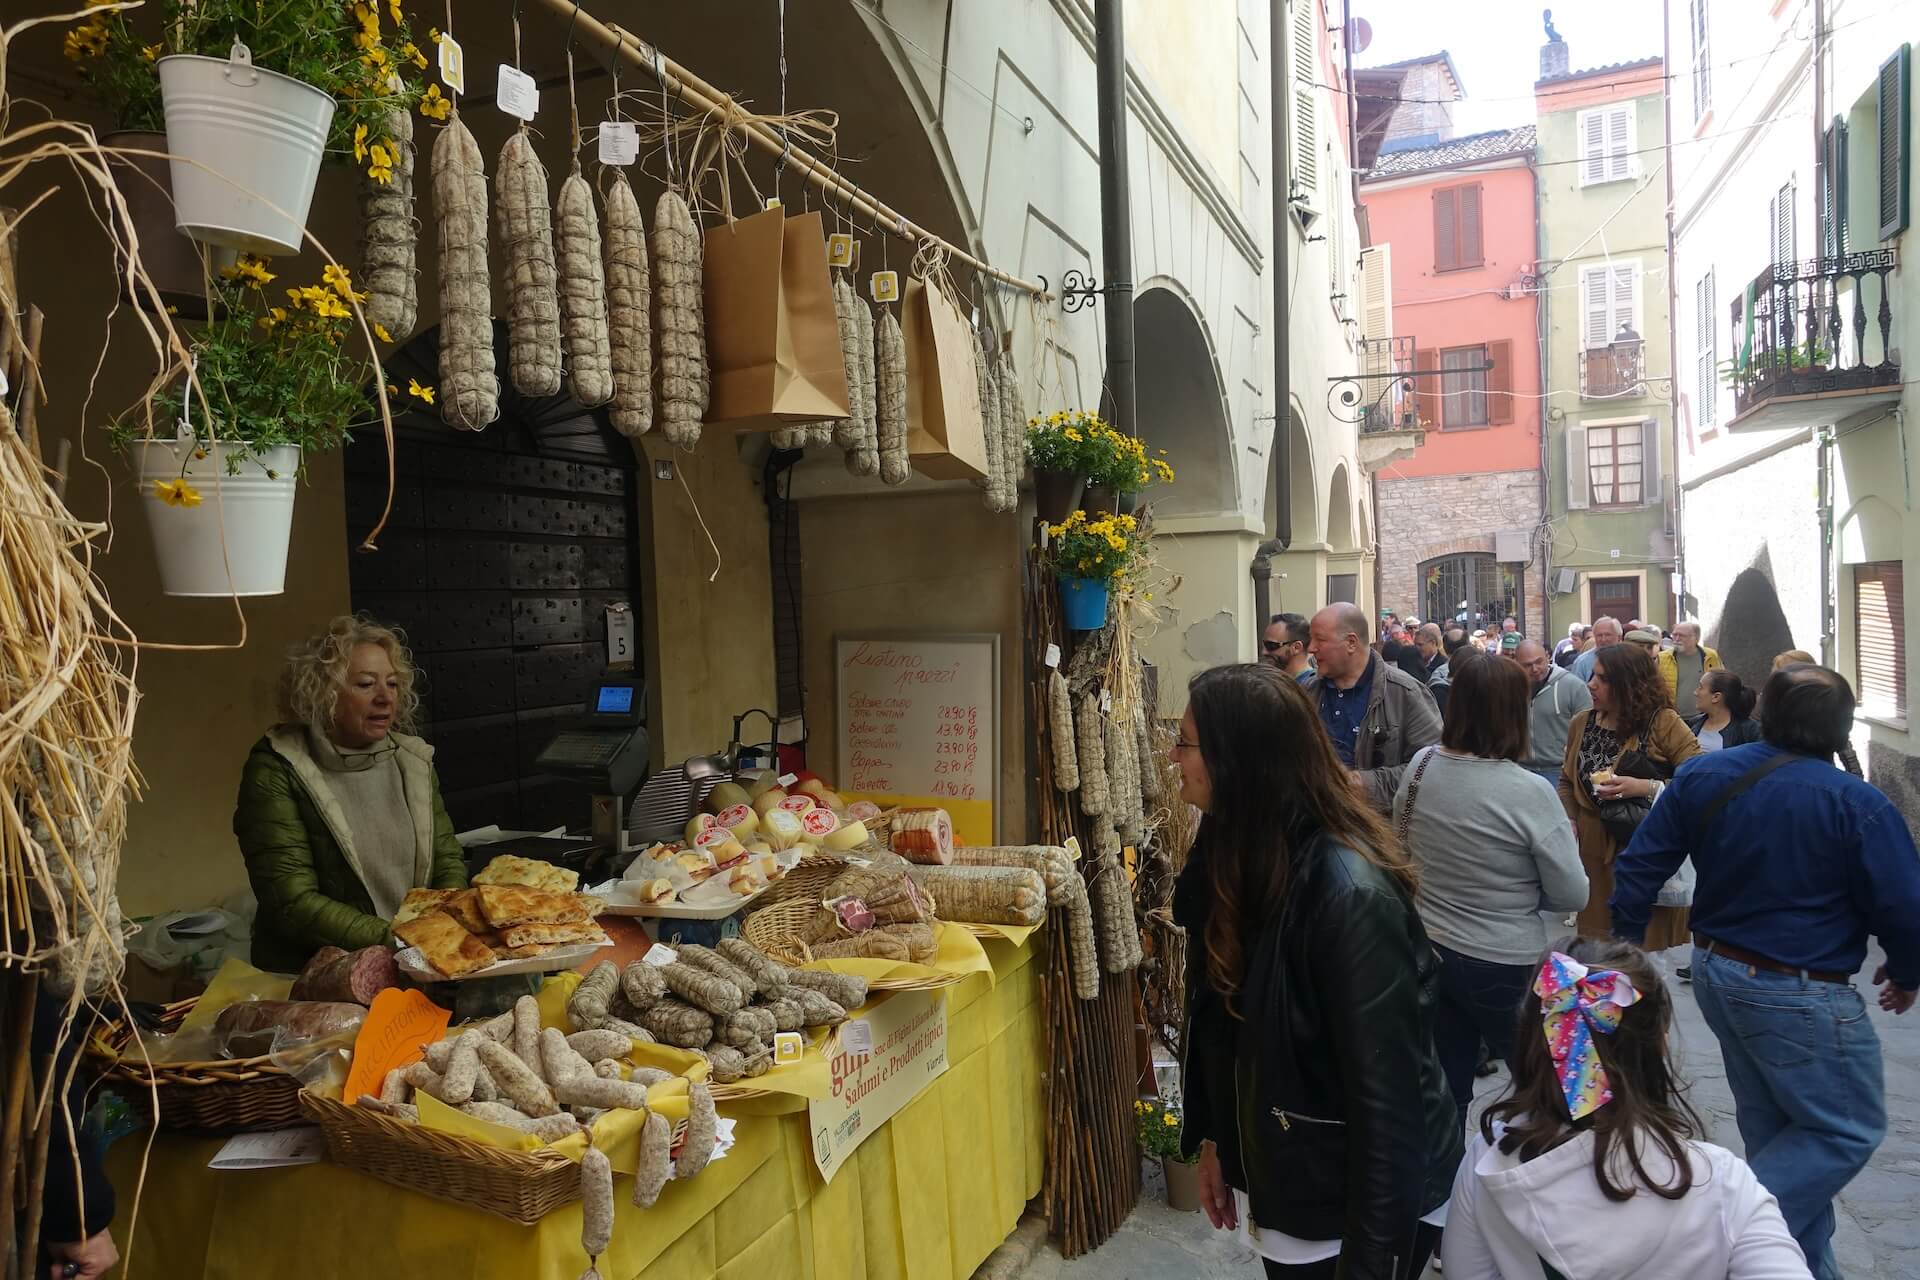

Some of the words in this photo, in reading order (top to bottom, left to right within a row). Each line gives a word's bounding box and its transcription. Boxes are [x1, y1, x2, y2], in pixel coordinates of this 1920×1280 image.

[618, 637, 626, 655] 5
[846, 1066, 880, 1108] Salumi
[882, 1067, 888, 1080] e
[890, 1033, 923, 1076] Prodotti
[924, 1017, 943, 1048] tipici
